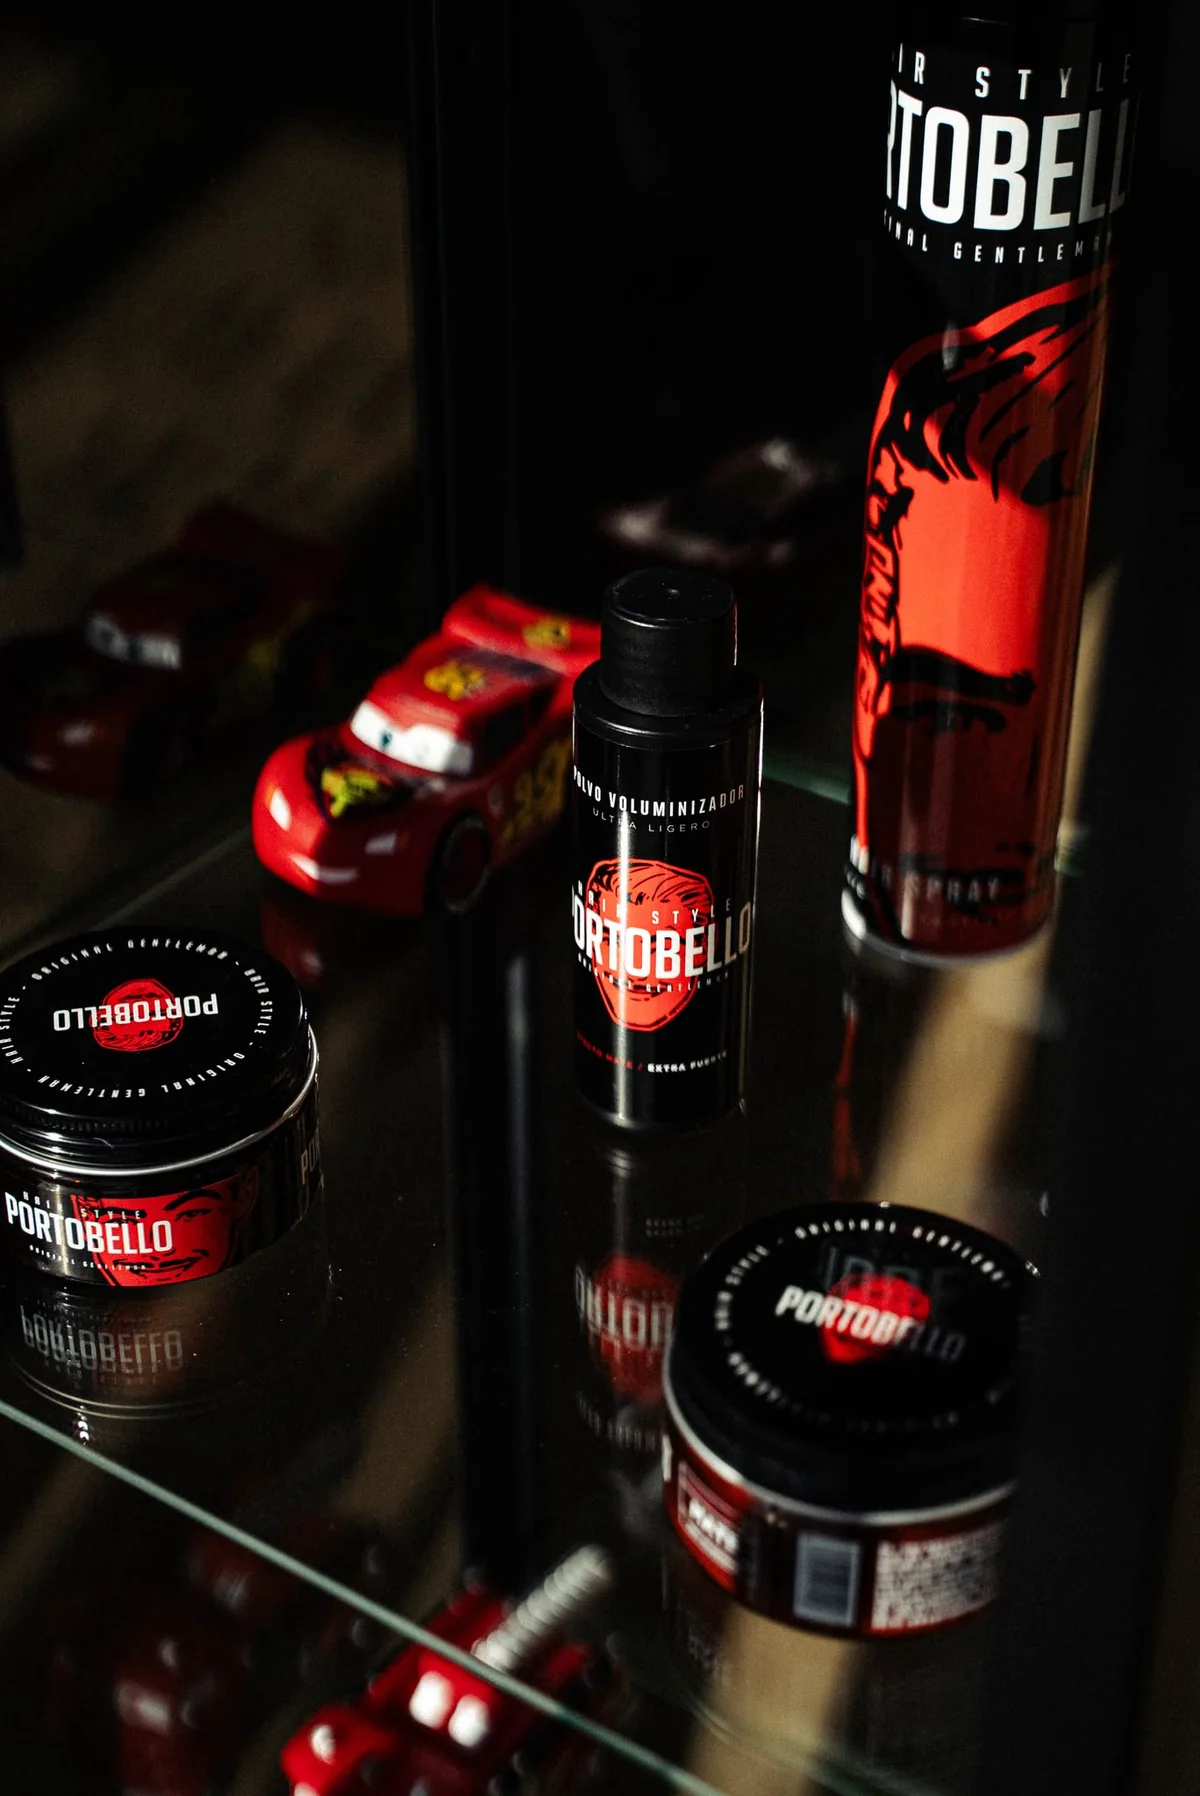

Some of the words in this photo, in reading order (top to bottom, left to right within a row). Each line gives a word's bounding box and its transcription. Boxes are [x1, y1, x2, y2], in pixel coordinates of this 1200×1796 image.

[892, 42, 926, 85] IR
[975, 53, 1132, 101] STYLE
[886, 78, 1142, 231] TOBELL
[609, 784, 744, 817] VOLUMINIZADOR
[649, 820, 710, 833] LIGERO
[651, 898, 731, 925] STYLE
[128, 937, 229, 960] GENTLEMAN
[571, 884, 751, 980] ORTOBELLO
[31, 941, 114, 981] ORIGINAL
[244, 968, 270, 994] HAIR
[53, 992, 219, 1033] PORTOBELLO
[254, 1000, 273, 1035] STYLE
[37, 1074, 146, 1099] GENTLEMAN
[161, 1051, 245, 1094] ORIGINAL
[4, 1191, 173, 1255] PORTOBELLO
[81, 1206, 141, 1220] STYLE
